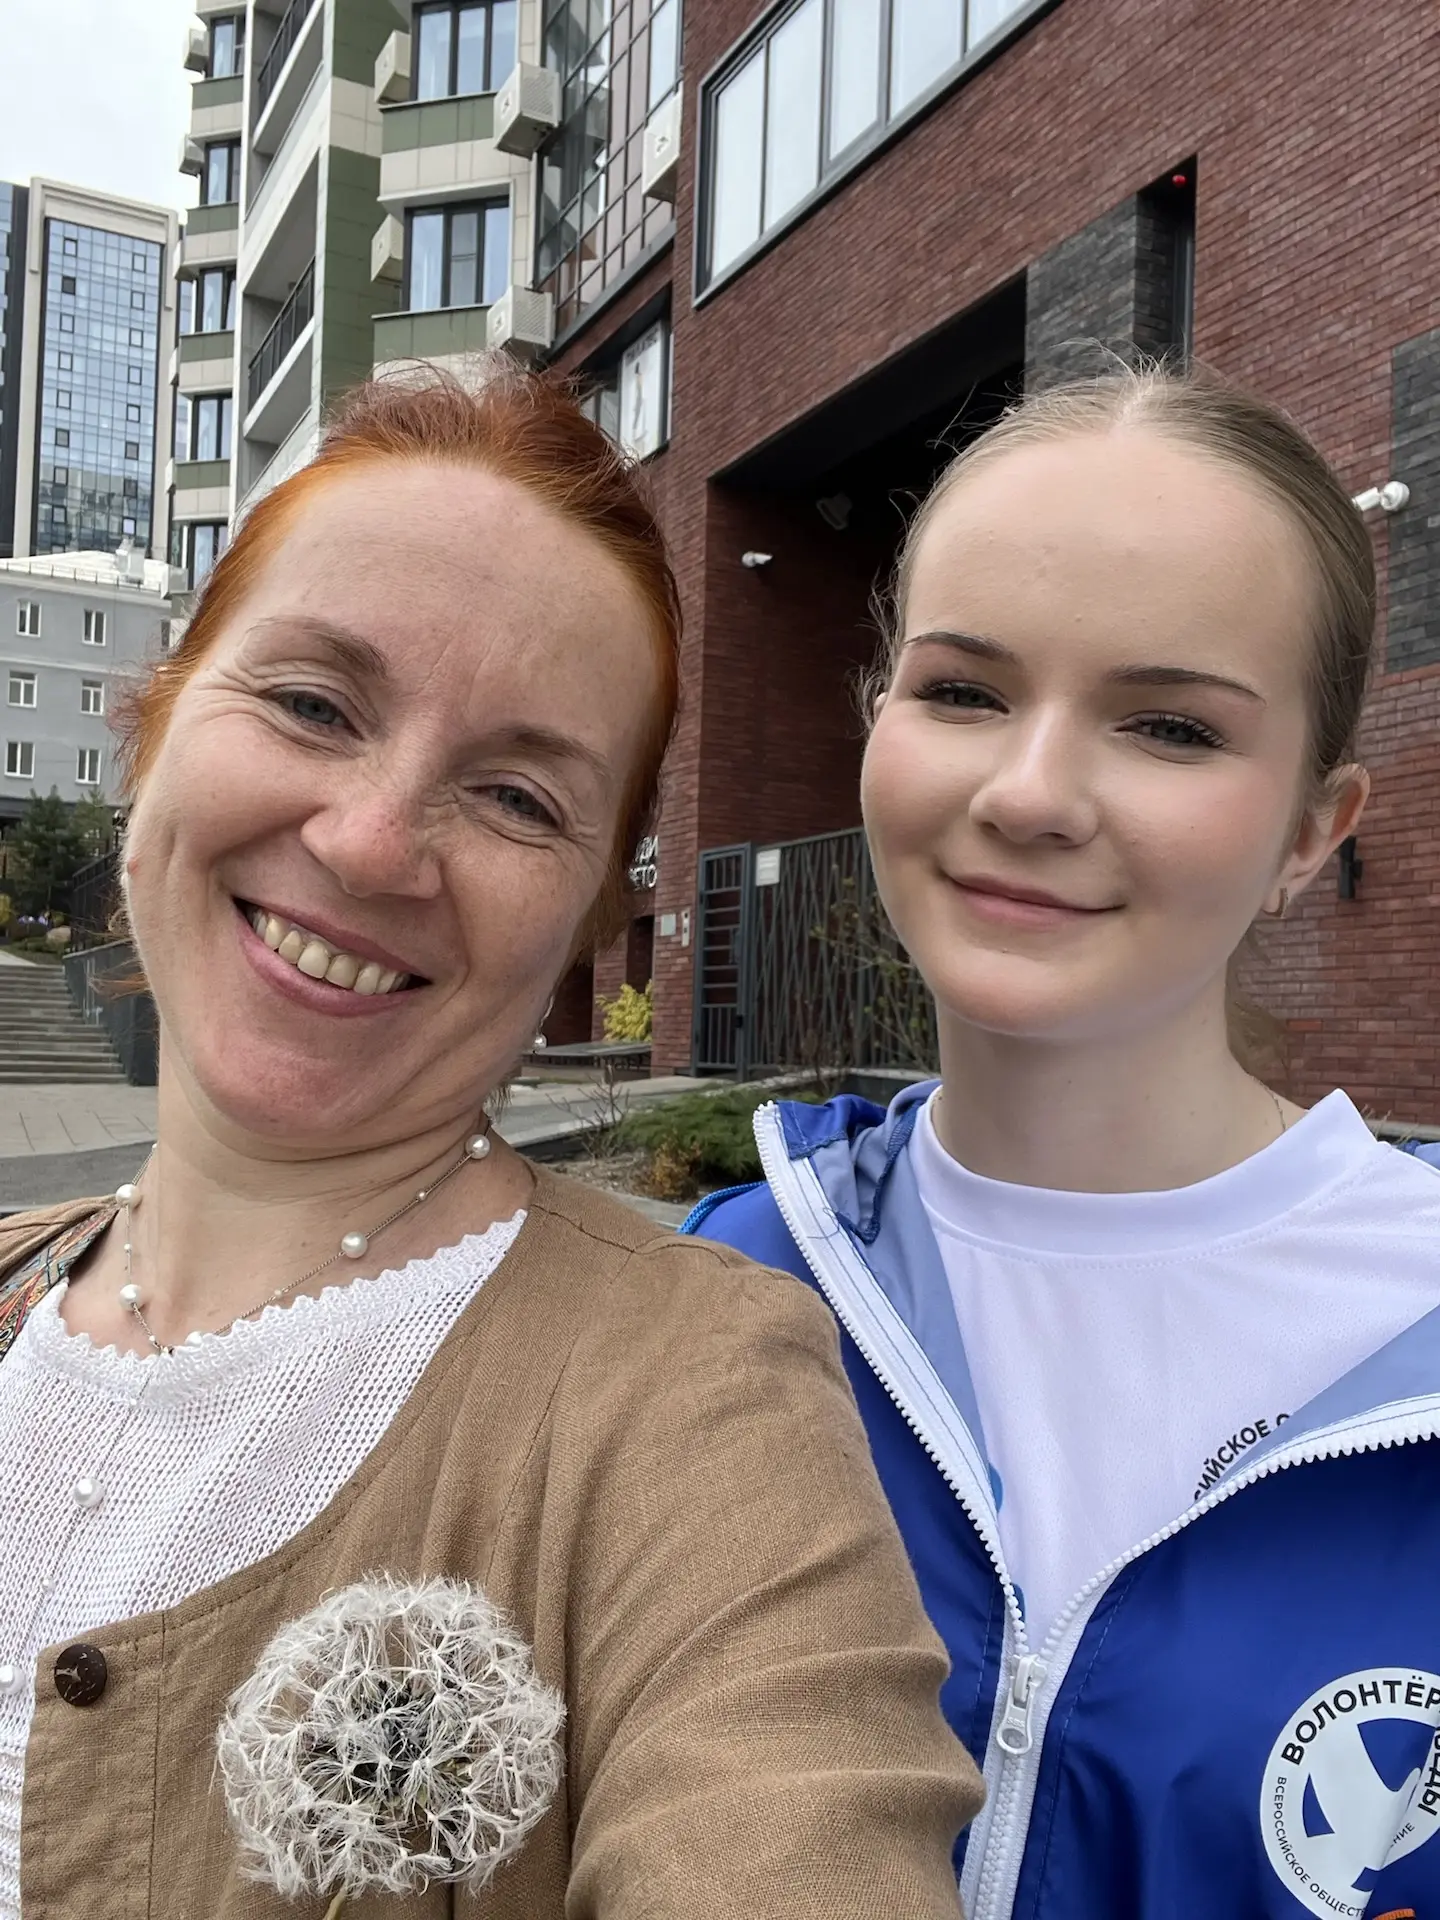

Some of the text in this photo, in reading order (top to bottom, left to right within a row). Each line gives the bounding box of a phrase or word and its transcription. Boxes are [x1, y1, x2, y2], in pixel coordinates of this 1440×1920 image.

[1281, 1675, 1440, 1766] ВОЛОНТЁР
[1273, 1776, 1311, 1884] ВСЕРОССИЙСКОЕ
[1390, 1822, 1416, 1848] НИЕ
